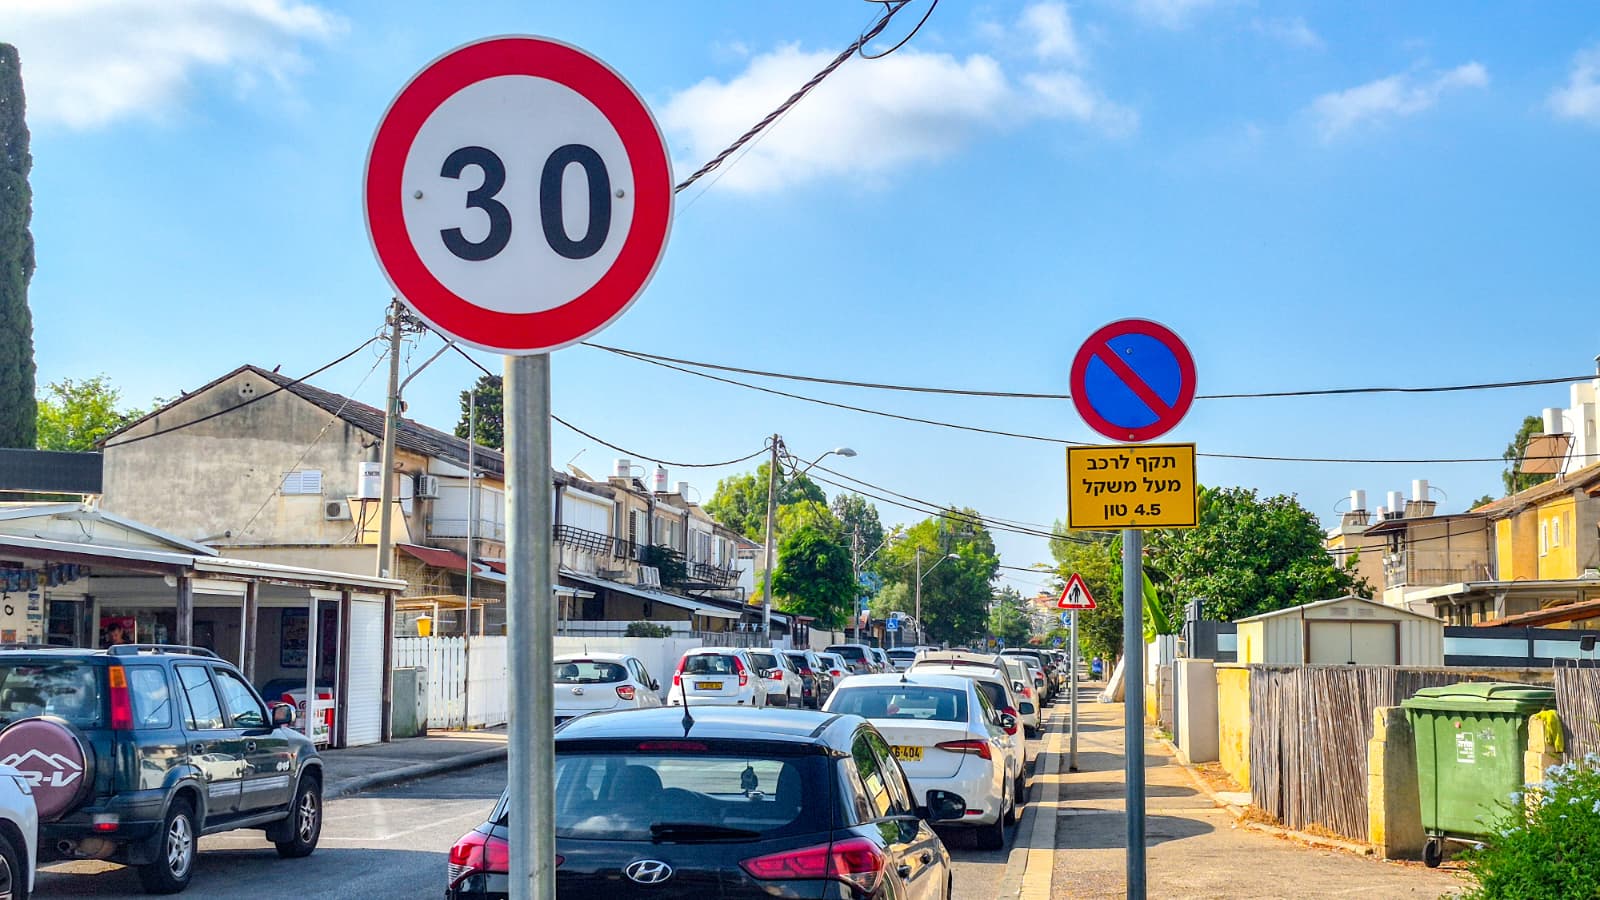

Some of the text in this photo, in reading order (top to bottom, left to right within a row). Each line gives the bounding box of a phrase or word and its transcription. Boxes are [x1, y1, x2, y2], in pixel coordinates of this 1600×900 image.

[440, 143, 612, 261] 30
[1087, 454, 1176, 472] תקף לרכב
[1082, 477, 1181, 496] מעל משקל
[1104, 504, 1161, 520] 4.5 טון
